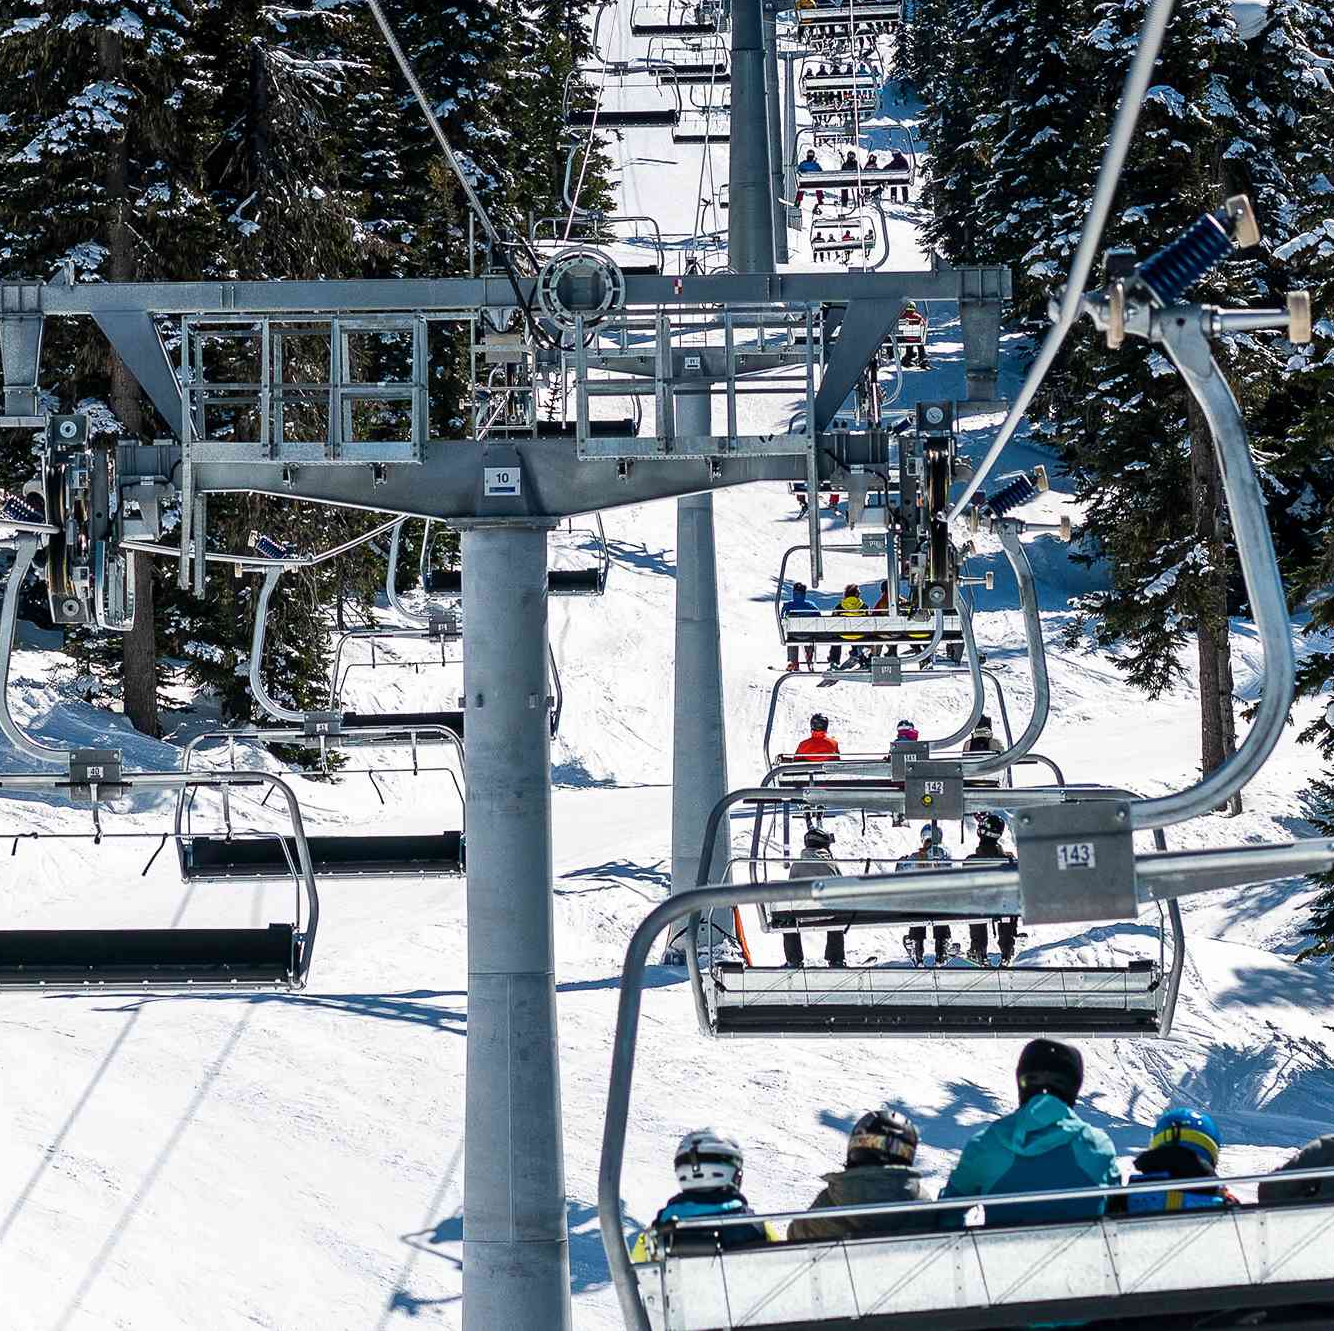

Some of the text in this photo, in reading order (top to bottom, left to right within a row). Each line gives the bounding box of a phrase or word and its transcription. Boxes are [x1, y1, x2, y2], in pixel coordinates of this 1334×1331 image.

[496, 472, 509, 483] 10
[926, 781, 942, 791] 142
[1060, 844, 1090, 862] 143
